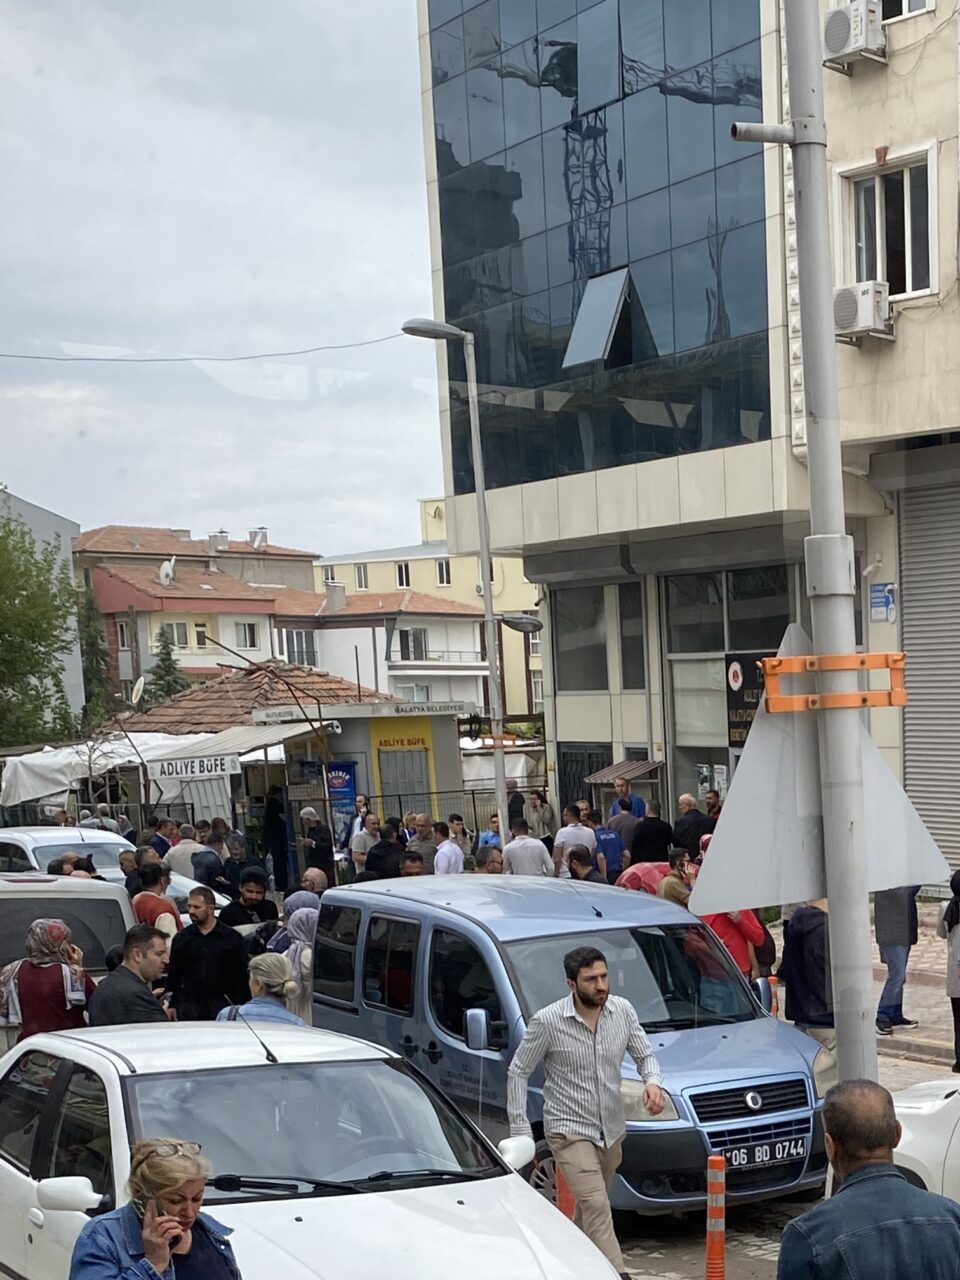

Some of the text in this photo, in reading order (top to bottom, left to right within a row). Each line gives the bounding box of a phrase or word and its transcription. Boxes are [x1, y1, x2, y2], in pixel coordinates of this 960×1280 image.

[395, 706, 425, 714] MALATYA
[378, 737, 426, 747] ADLİYE BÜFE
[160, 757, 226, 776] ADLİYE BÜFE
[732, 1140, 804, 1165] 06 BD 0744
